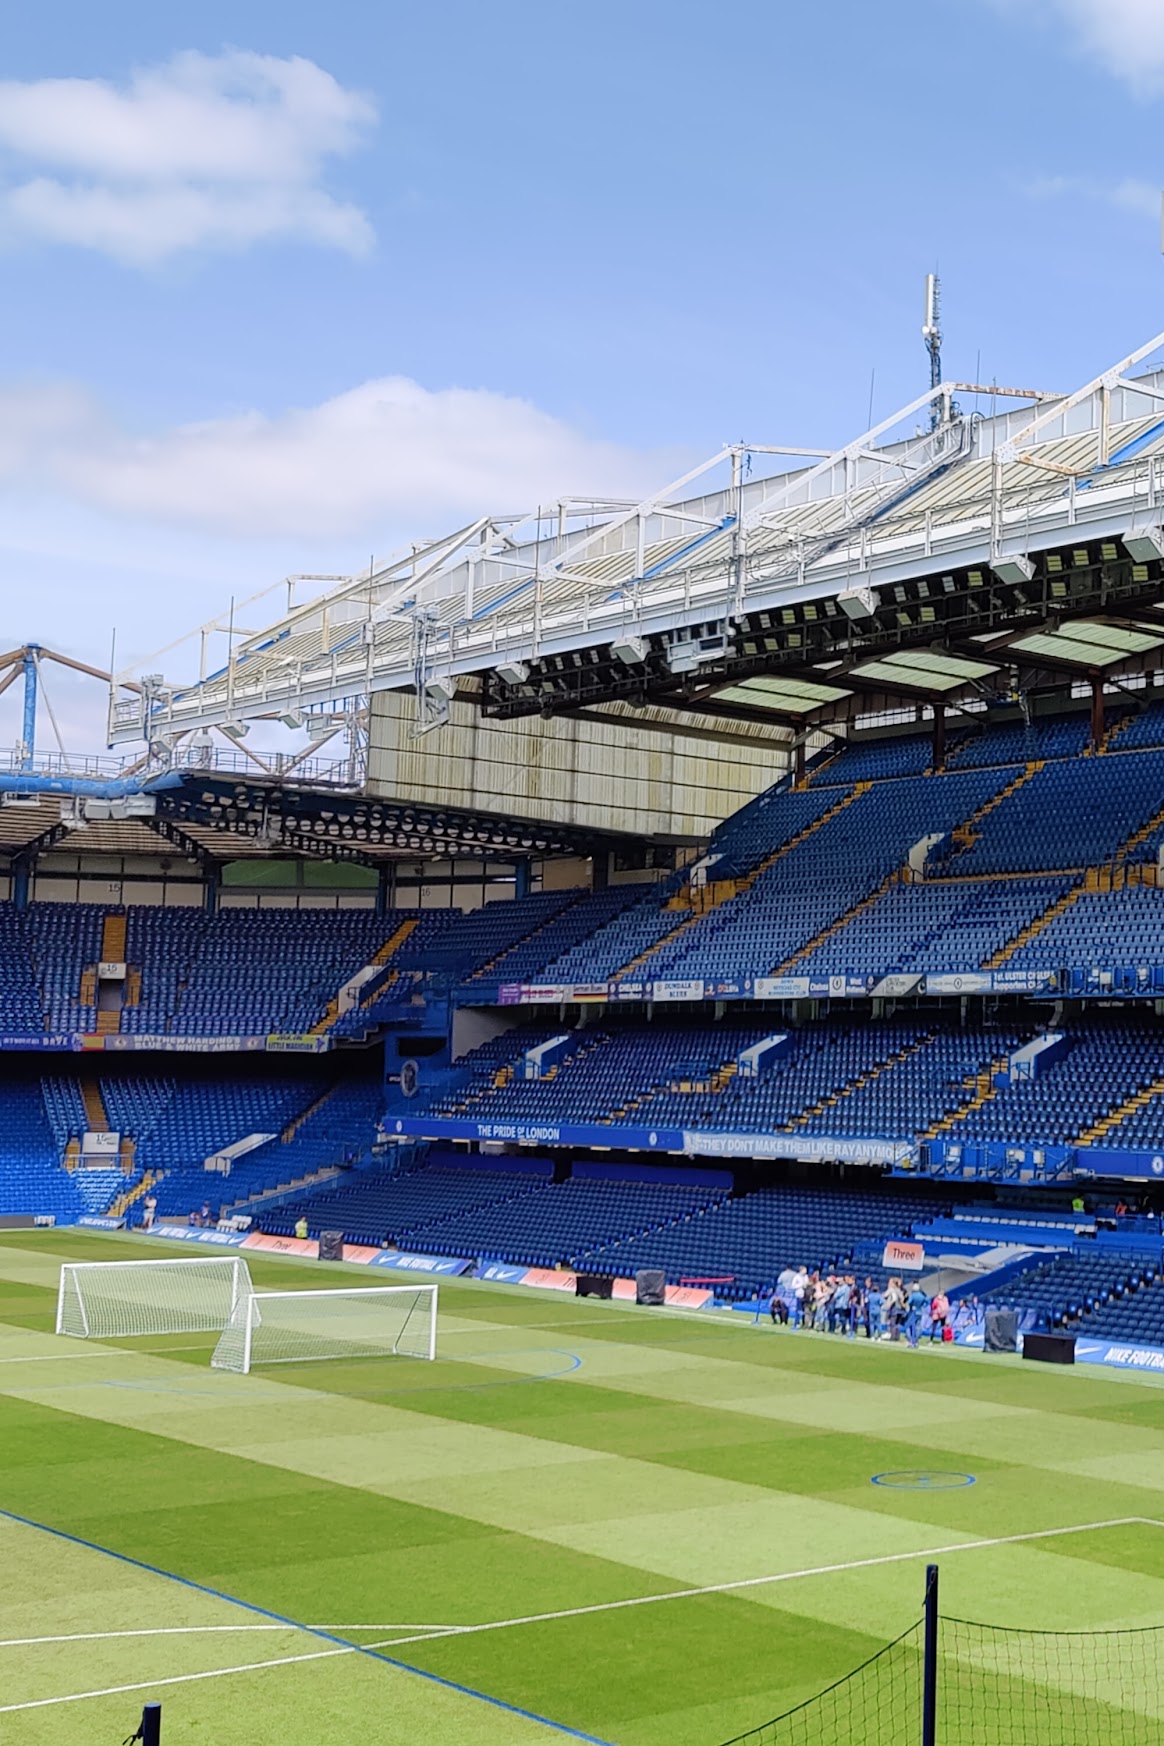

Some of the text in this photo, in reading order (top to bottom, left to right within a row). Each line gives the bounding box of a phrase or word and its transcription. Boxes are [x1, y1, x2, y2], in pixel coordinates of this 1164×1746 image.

[109, 884, 120, 892] 15
[421, 887, 431, 897] 16
[1005, 971, 1026, 981] ULSTER
[993, 980, 1026, 991] Supporters
[134, 1035, 241, 1045] MATTHEW HARDING'S
[135, 1042, 162, 1050] BLUE
[176, 1043, 209, 1052] WHITE
[212, 1043, 241, 1052] ARMY
[477, 1124, 560, 1141] THE PRIDE OF LONDON
[703, 1138, 726, 1151] THEY
[728, 1138, 754, 1152] DONT
[756, 1139, 784, 1153] MAKE
[784, 1139, 811, 1154] THEM
[811, 1142, 834, 1154] LIKE
[834, 1143, 857, 1156] RAY
[893, 1247, 916, 1261] Three
[1104, 1346, 1132, 1364] NIKE
